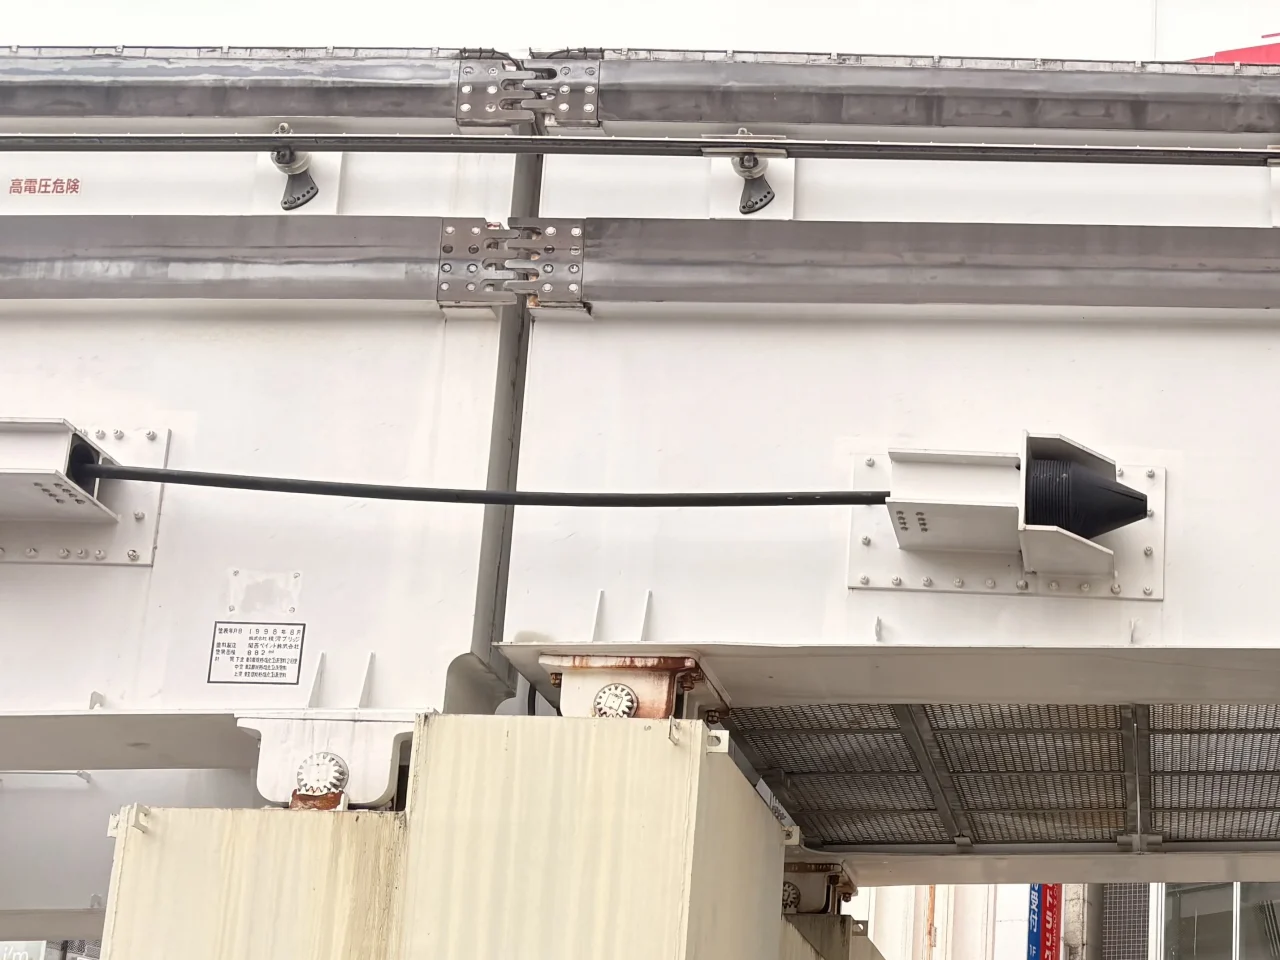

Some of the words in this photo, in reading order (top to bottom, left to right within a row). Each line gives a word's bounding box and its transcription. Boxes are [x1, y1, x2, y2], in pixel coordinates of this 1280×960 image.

[9, 178, 80, 194] 高電圧危険
